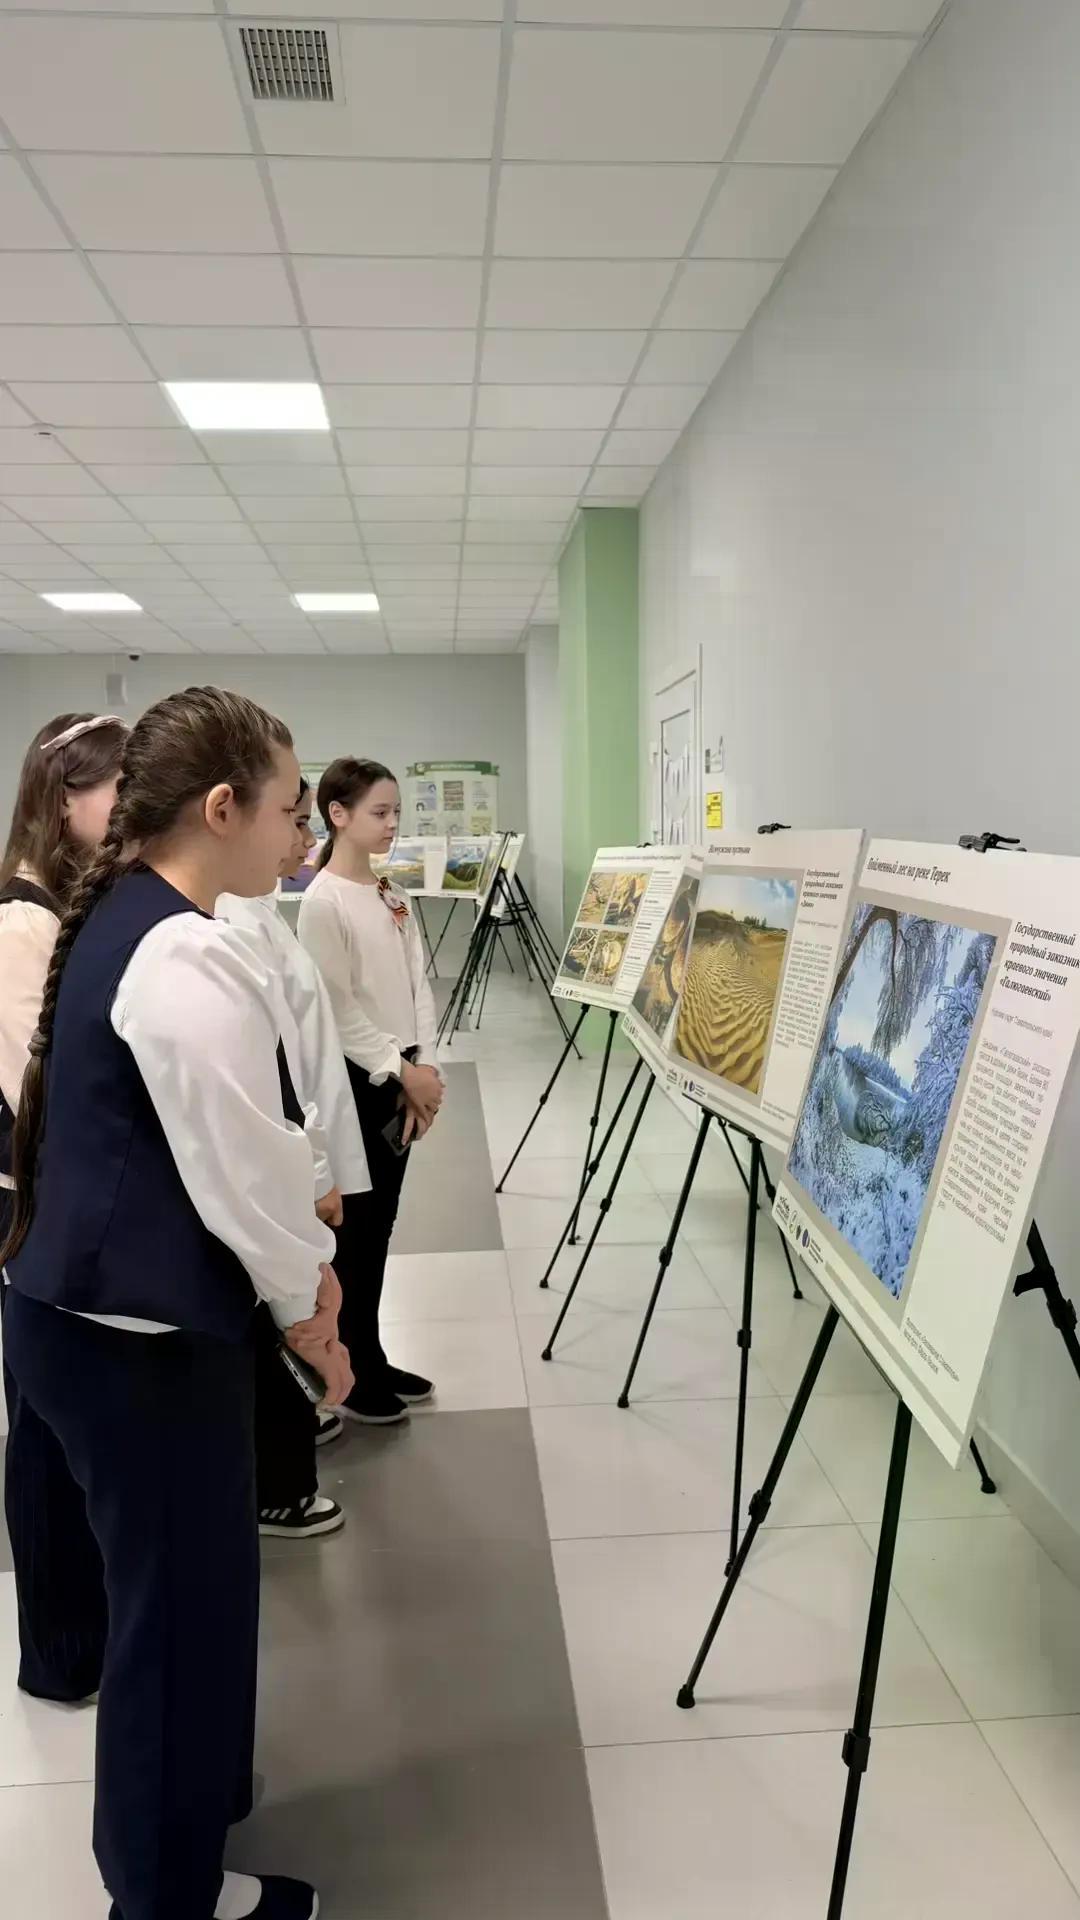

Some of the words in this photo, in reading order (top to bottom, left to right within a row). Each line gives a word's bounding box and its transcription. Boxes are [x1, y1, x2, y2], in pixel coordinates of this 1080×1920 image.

[896, 864, 908, 876] лес
[913, 867, 931, 881] реке
[930, 866, 951, 885] Терек
[1015, 922, 1077, 946] Государственный
[1009, 942, 1048, 959] природный
[1046, 952, 1080, 969] заказник
[1004, 960, 1034, 976] краевого
[1033, 968, 1068, 986] значения
[1000, 976, 1052, 1002] «Галюгаевский»
